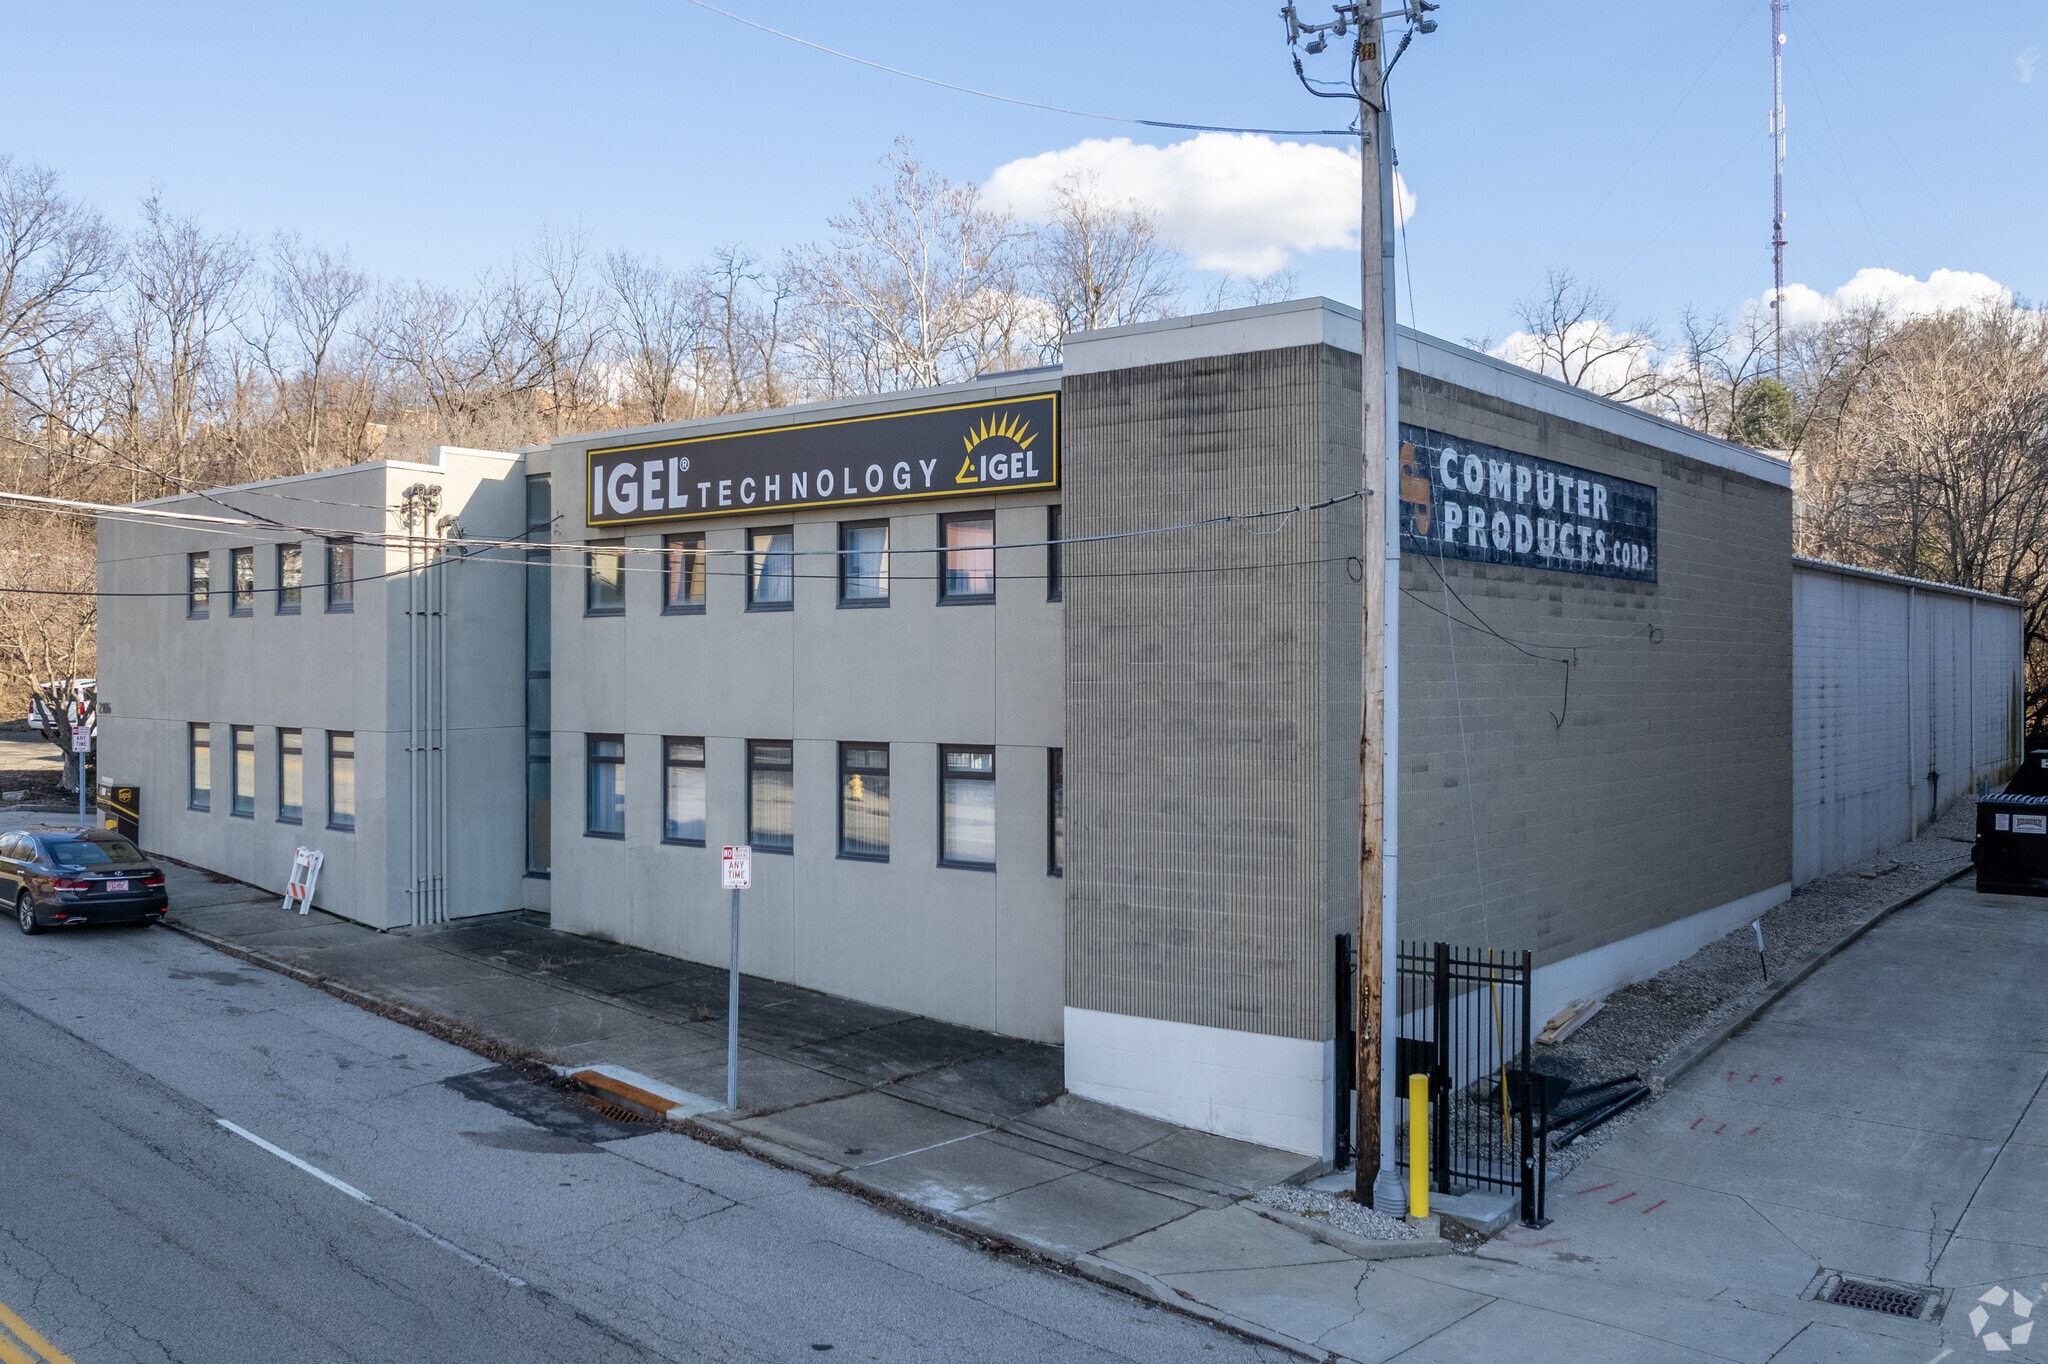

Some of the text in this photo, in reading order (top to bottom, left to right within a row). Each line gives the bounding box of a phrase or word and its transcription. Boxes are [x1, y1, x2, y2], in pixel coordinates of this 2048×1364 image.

[697, 458, 938, 508] TECHNOLOGY
[980, 450, 1040, 482] IGEL
[1439, 447, 1609, 521] COMPUTER
[1443, 501, 1649, 570] PRODUCTS CORP
[728, 861, 745, 869] ANY
[728, 870, 745, 879] TIME
